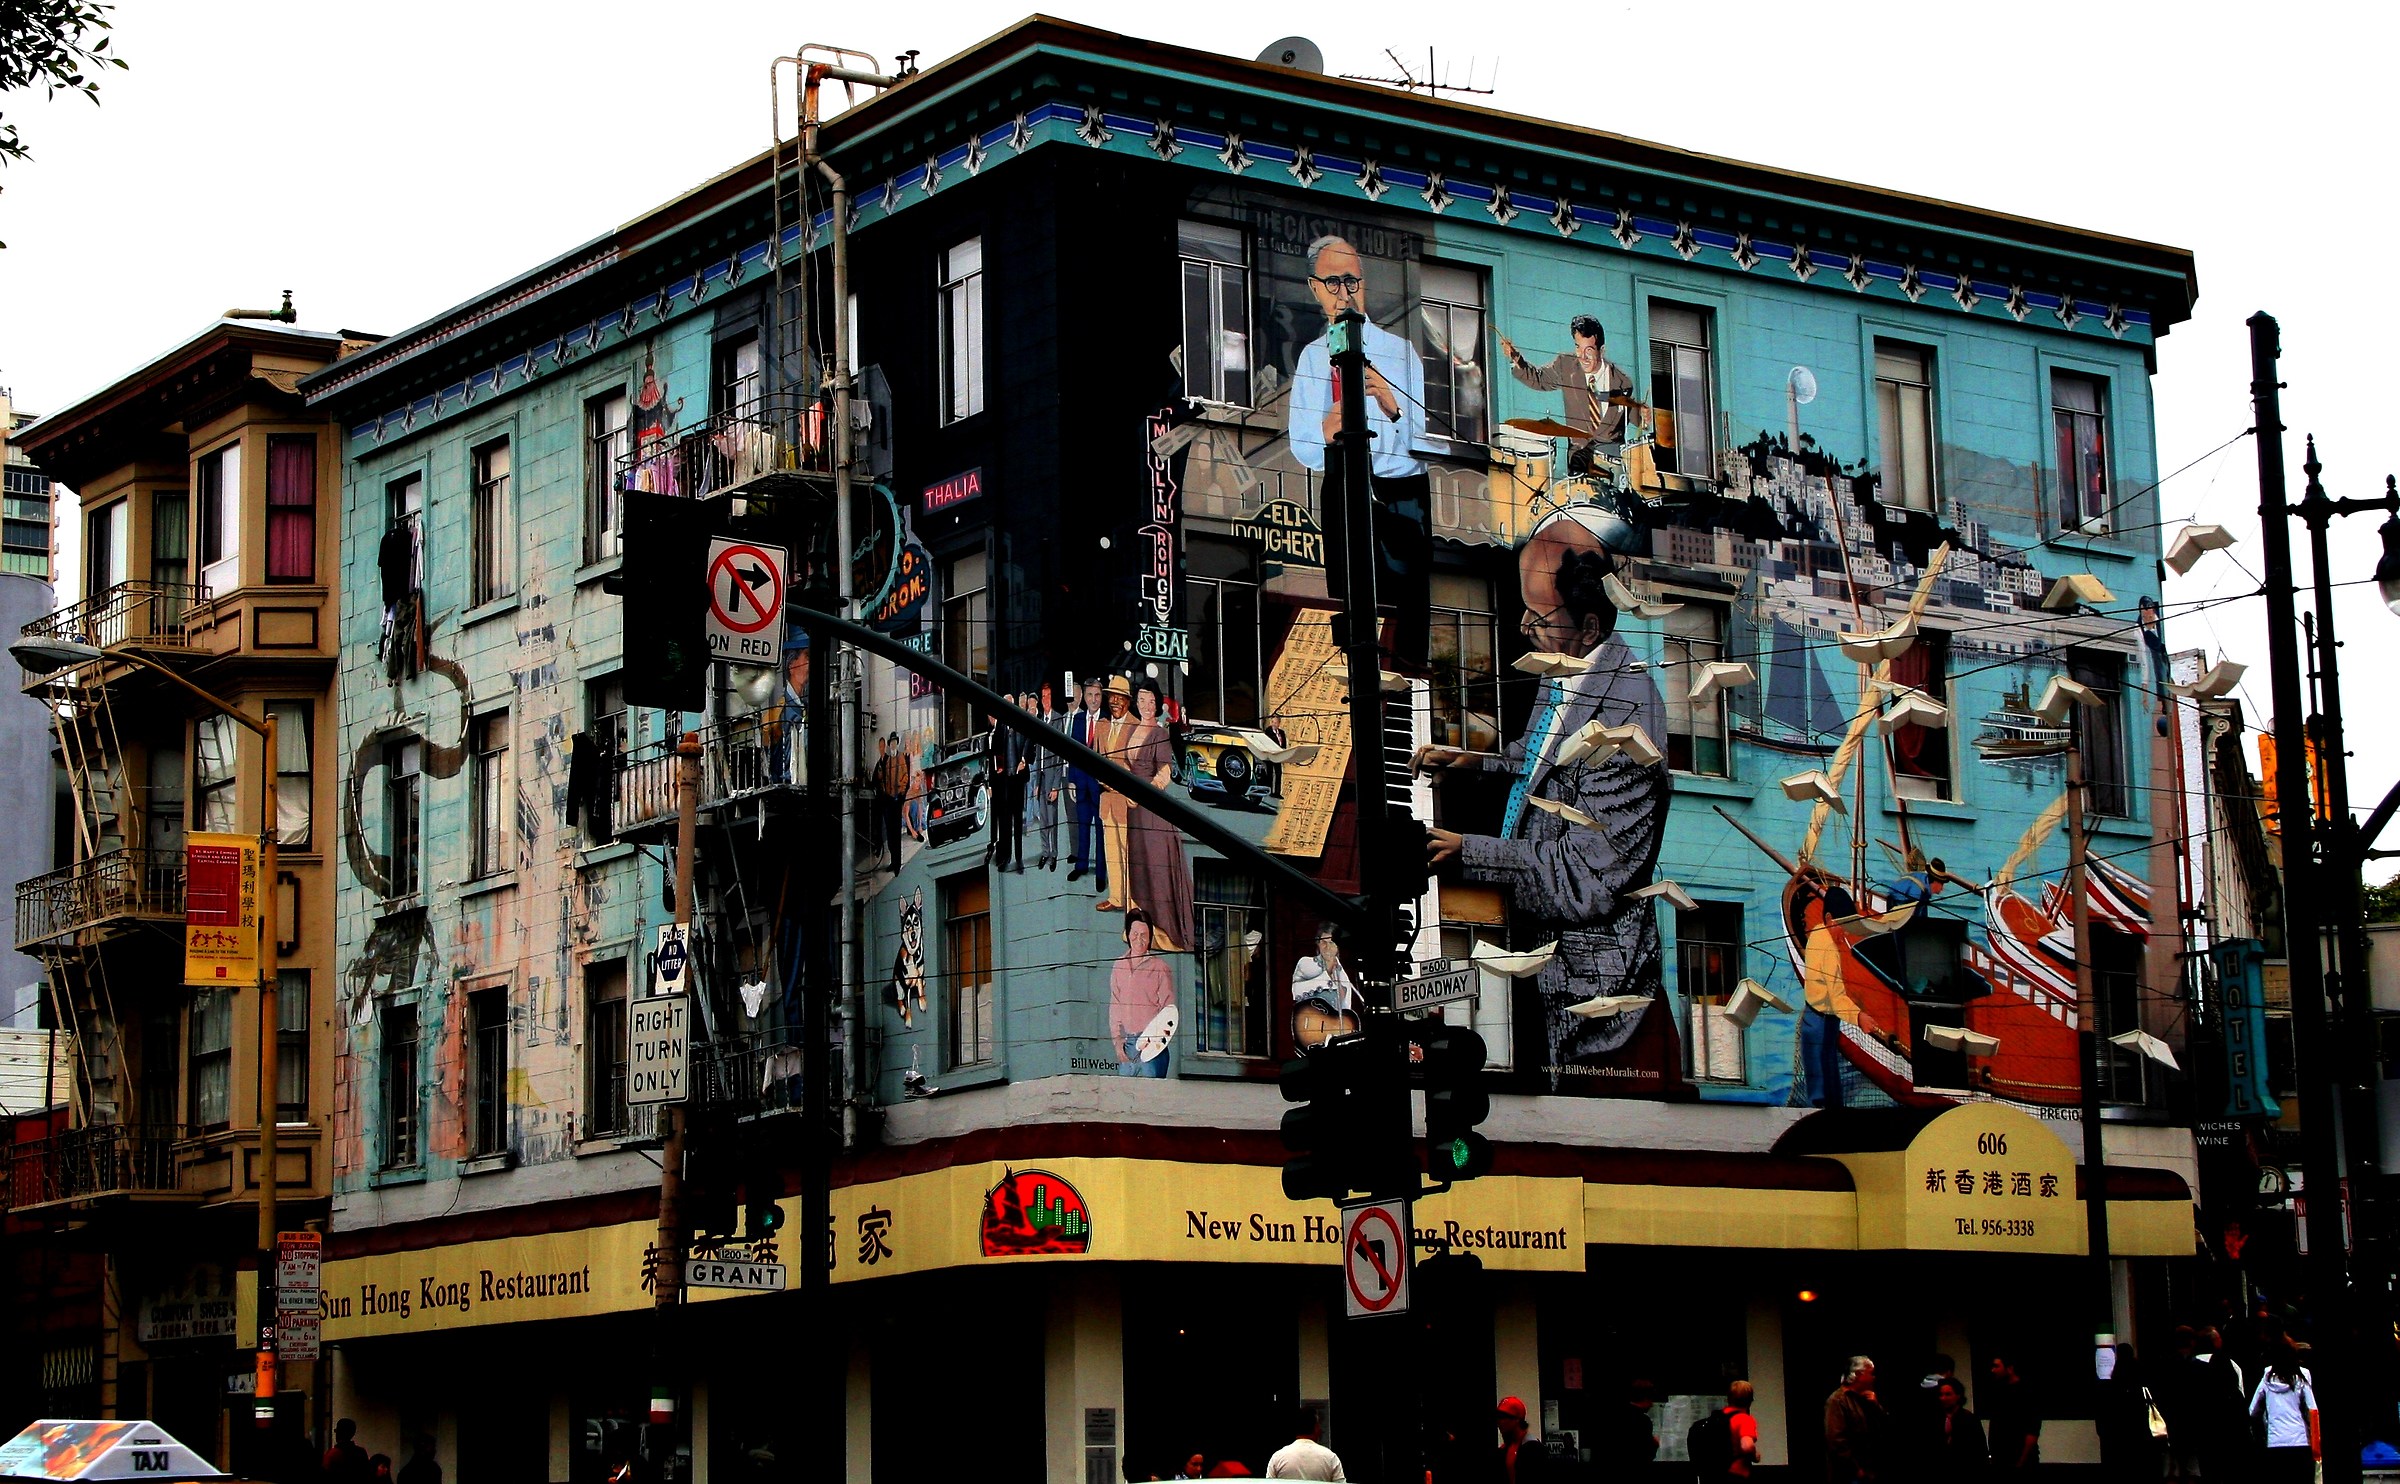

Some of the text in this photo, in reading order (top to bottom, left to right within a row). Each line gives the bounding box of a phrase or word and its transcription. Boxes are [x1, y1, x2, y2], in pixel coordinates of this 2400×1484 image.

[1153, 422, 1168, 519] MULIN
[924, 473, 979, 509] THALIA
[1234, 524, 1325, 566] DOUGHERT
[1156, 530, 1168, 611] ROUGE
[709, 633, 772, 656] ON RED
[241, 848, 256, 928] 聖瑪利學校
[661, 957, 682, 971] LITTER
[1428, 959, 1446, 973] 600
[1402, 974, 1468, 1003] BROADWAY
[635, 1008, 682, 1032] RIGHT
[2225, 952, 2249, 1110] HOTEL
[635, 1038, 682, 1062] TURN
[1071, 1057, 1120, 1070] Bill Weber
[1541, 1064, 1660, 1079] www.BillWeberMuralist.com
[634, 1068, 681, 1093] ONLY
[2198, 1122, 2241, 1131] WICHES
[1977, 1132, 2008, 1155] 606
[2196, 1135, 2230, 1146] WINE
[1926, 1168, 2059, 1198] 新香港酒家
[1186, 1210, 1567, 1253] New Sun Ho ng Restaurant
[1955, 1218, 2034, 1236] Tel. 956-3338
[281, 1250, 319, 1260] NO STOPPING
[721, 1250, 741, 1259] 1200
[692, 1264, 778, 1285] GRANT
[319, 1264, 590, 1321] Sun Hong Kong Restaurant
[279, 1315, 318, 1328] NO PARKING
[132, 1451, 169, 1471] TAXI
